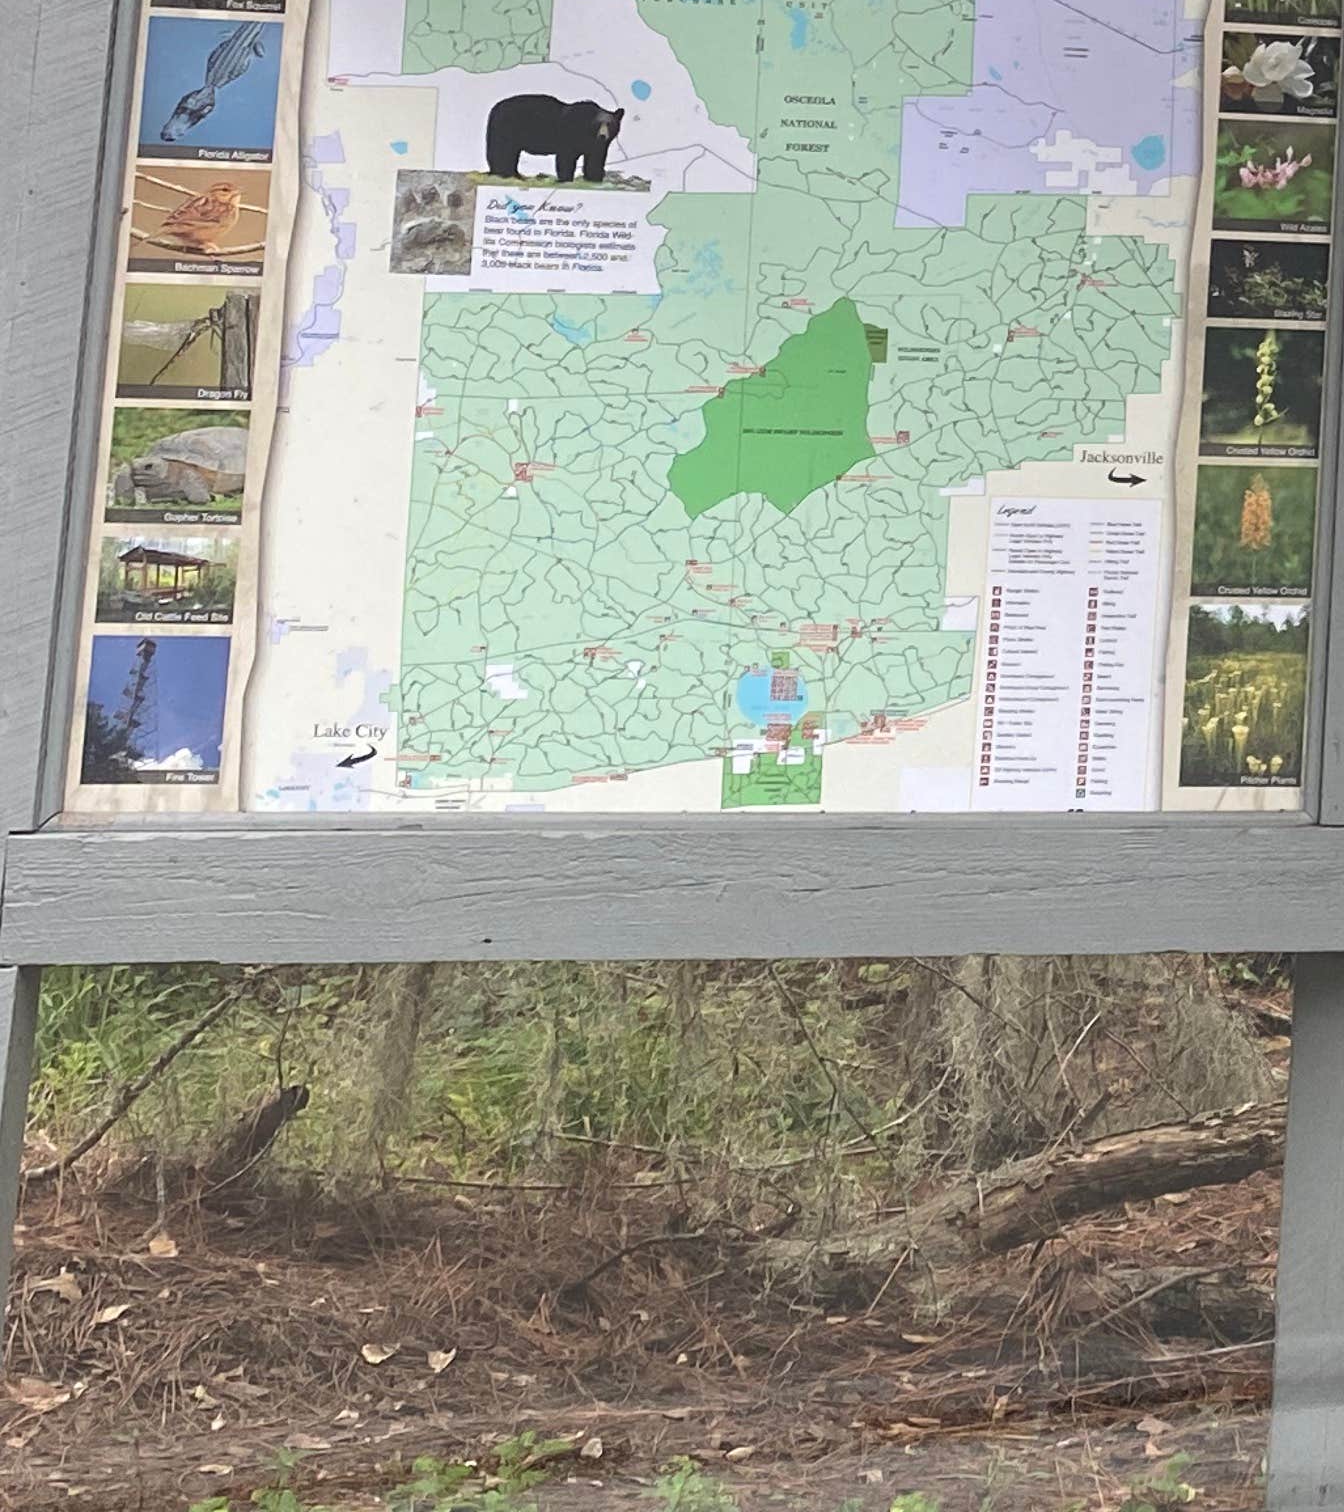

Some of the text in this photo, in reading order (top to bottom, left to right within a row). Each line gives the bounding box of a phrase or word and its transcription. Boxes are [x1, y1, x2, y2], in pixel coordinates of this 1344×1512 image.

[784, 95, 836, 105] OSCEOLA
[780, 119, 838, 129] NATIONAL
[785, 143, 830, 152] FOREST
[1080, 449, 1164, 465] Jacksonville
[313, 723, 388, 741] Lake City
